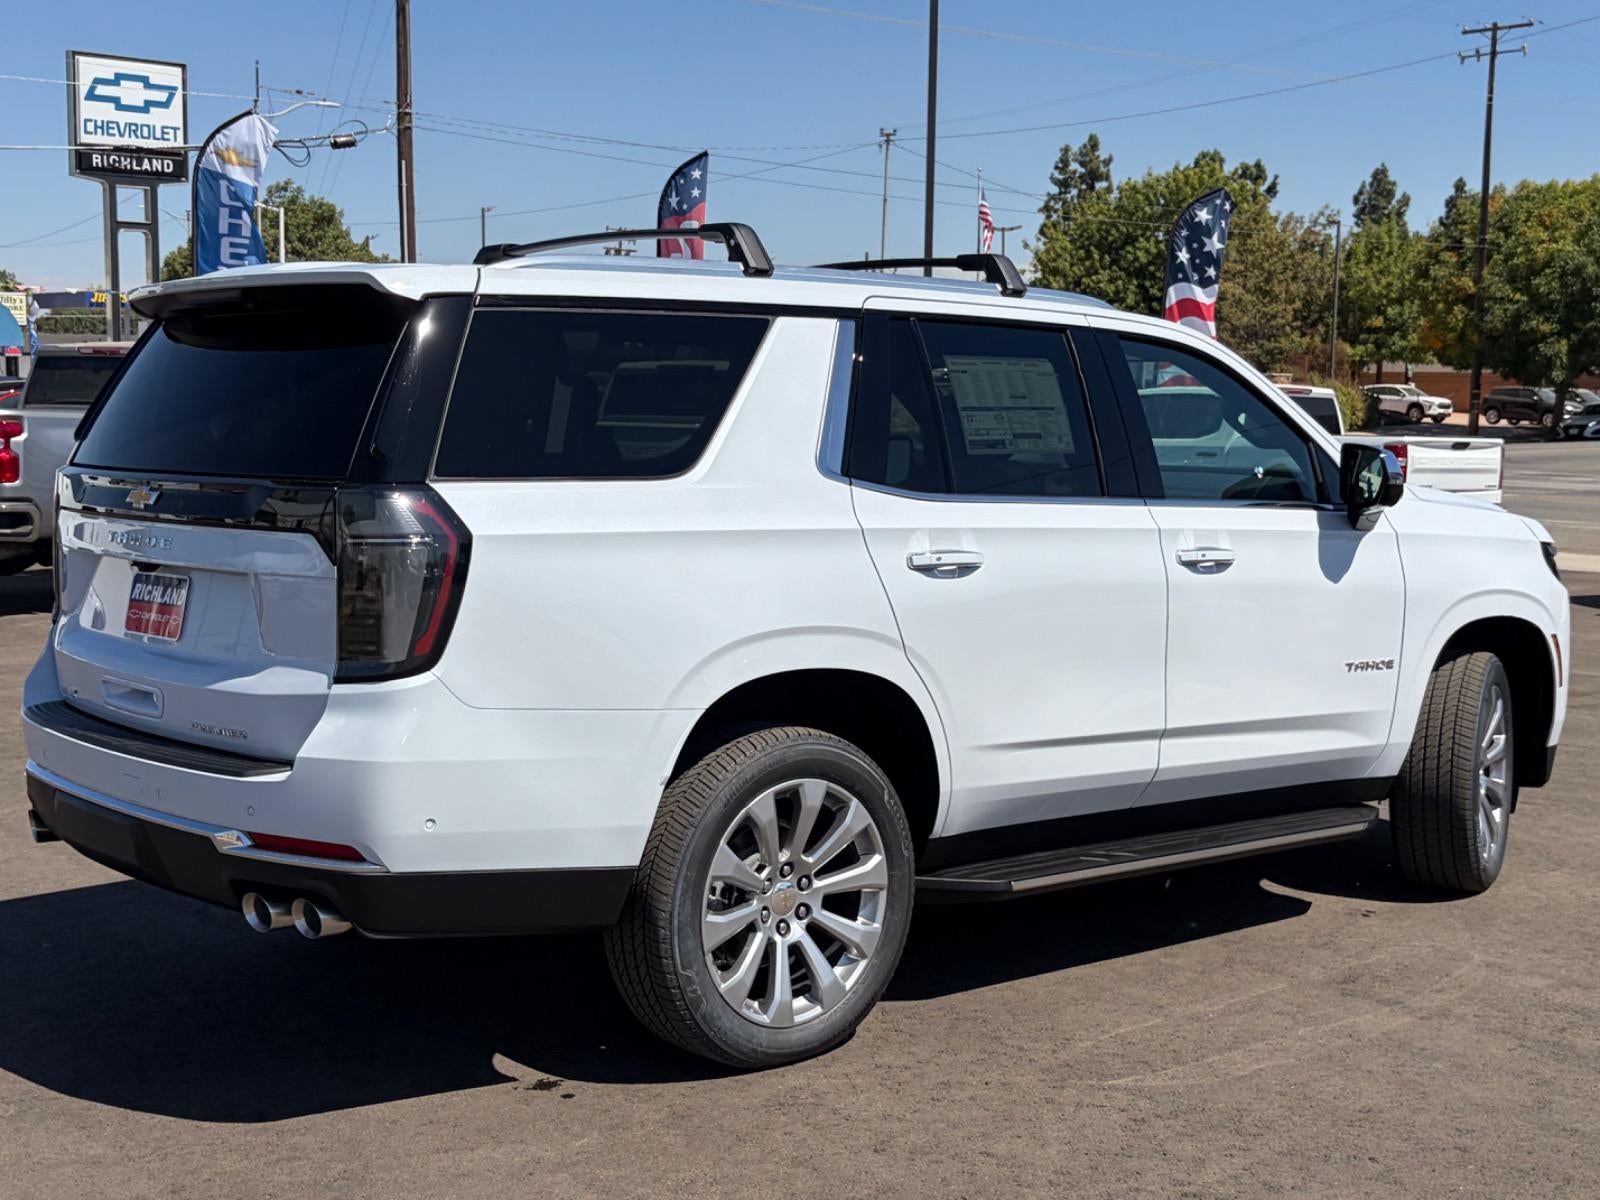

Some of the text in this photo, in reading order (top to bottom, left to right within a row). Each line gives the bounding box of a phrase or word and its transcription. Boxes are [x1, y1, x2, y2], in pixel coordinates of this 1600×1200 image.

[83, 118, 181, 142] CHEVROLET
[92, 153, 174, 173] RICHLAND
[218, 179, 251, 268] CHE
[108, 530, 173, 549] TAHOE
[131, 583, 187, 606] RICHLAND
[1345, 659, 1394, 673] TAHOE
